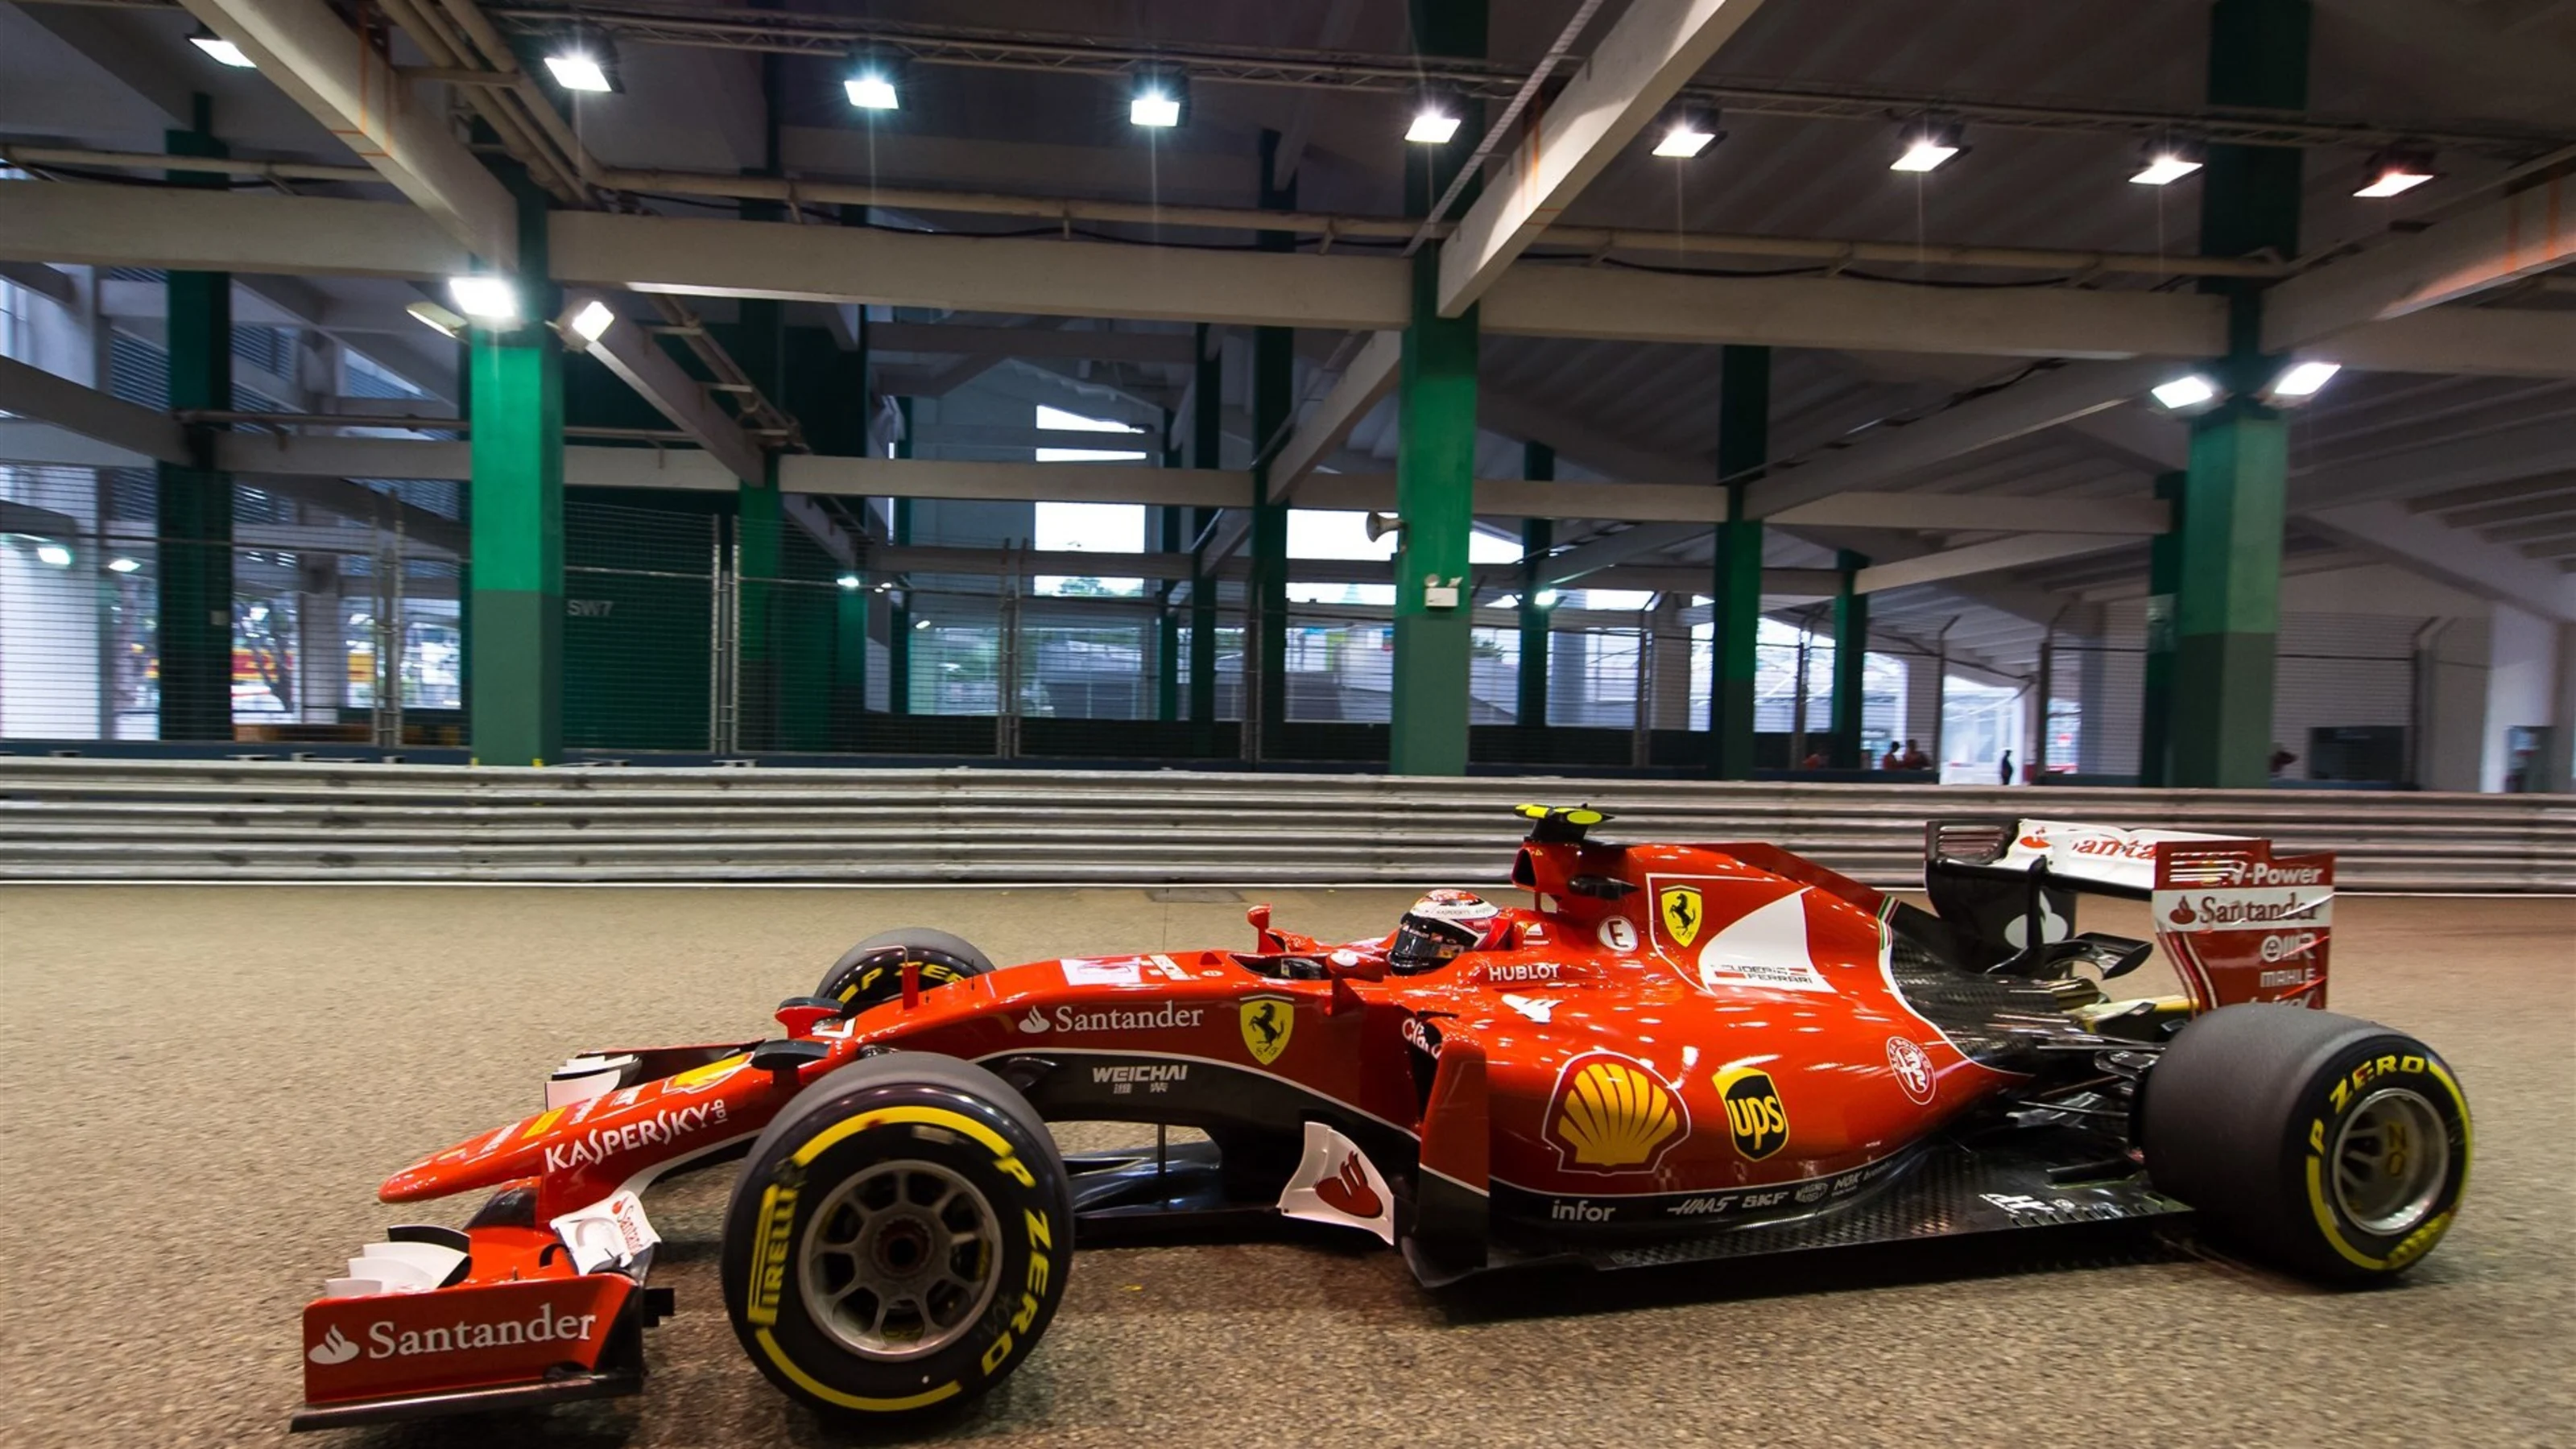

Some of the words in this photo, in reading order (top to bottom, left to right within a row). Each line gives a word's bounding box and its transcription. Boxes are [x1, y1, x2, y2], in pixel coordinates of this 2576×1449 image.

[567, 600, 614, 616] SW7
[2073, 839, 2157, 860] anta
[2199, 891, 2317, 924] Santander
[1608, 920, 1628, 947] E
[1490, 963, 1561, 981] HUBLOT
[1056, 1000, 1204, 1032] Santander
[1093, 1064, 1188, 1083] WEICHAI
[2330, 1055, 2425, 1114] ZERO
[544, 1102, 709, 1173] KASPERSKY
[1552, 1199, 1616, 1222] infor
[1667, 1195, 1738, 1215] HAAS
[1742, 1191, 1789, 1208] SKF
[747, 1183, 800, 1326] PIRELLI
[981, 1208, 1052, 1376] ZERO
[368, 1302, 597, 1359] Santander
